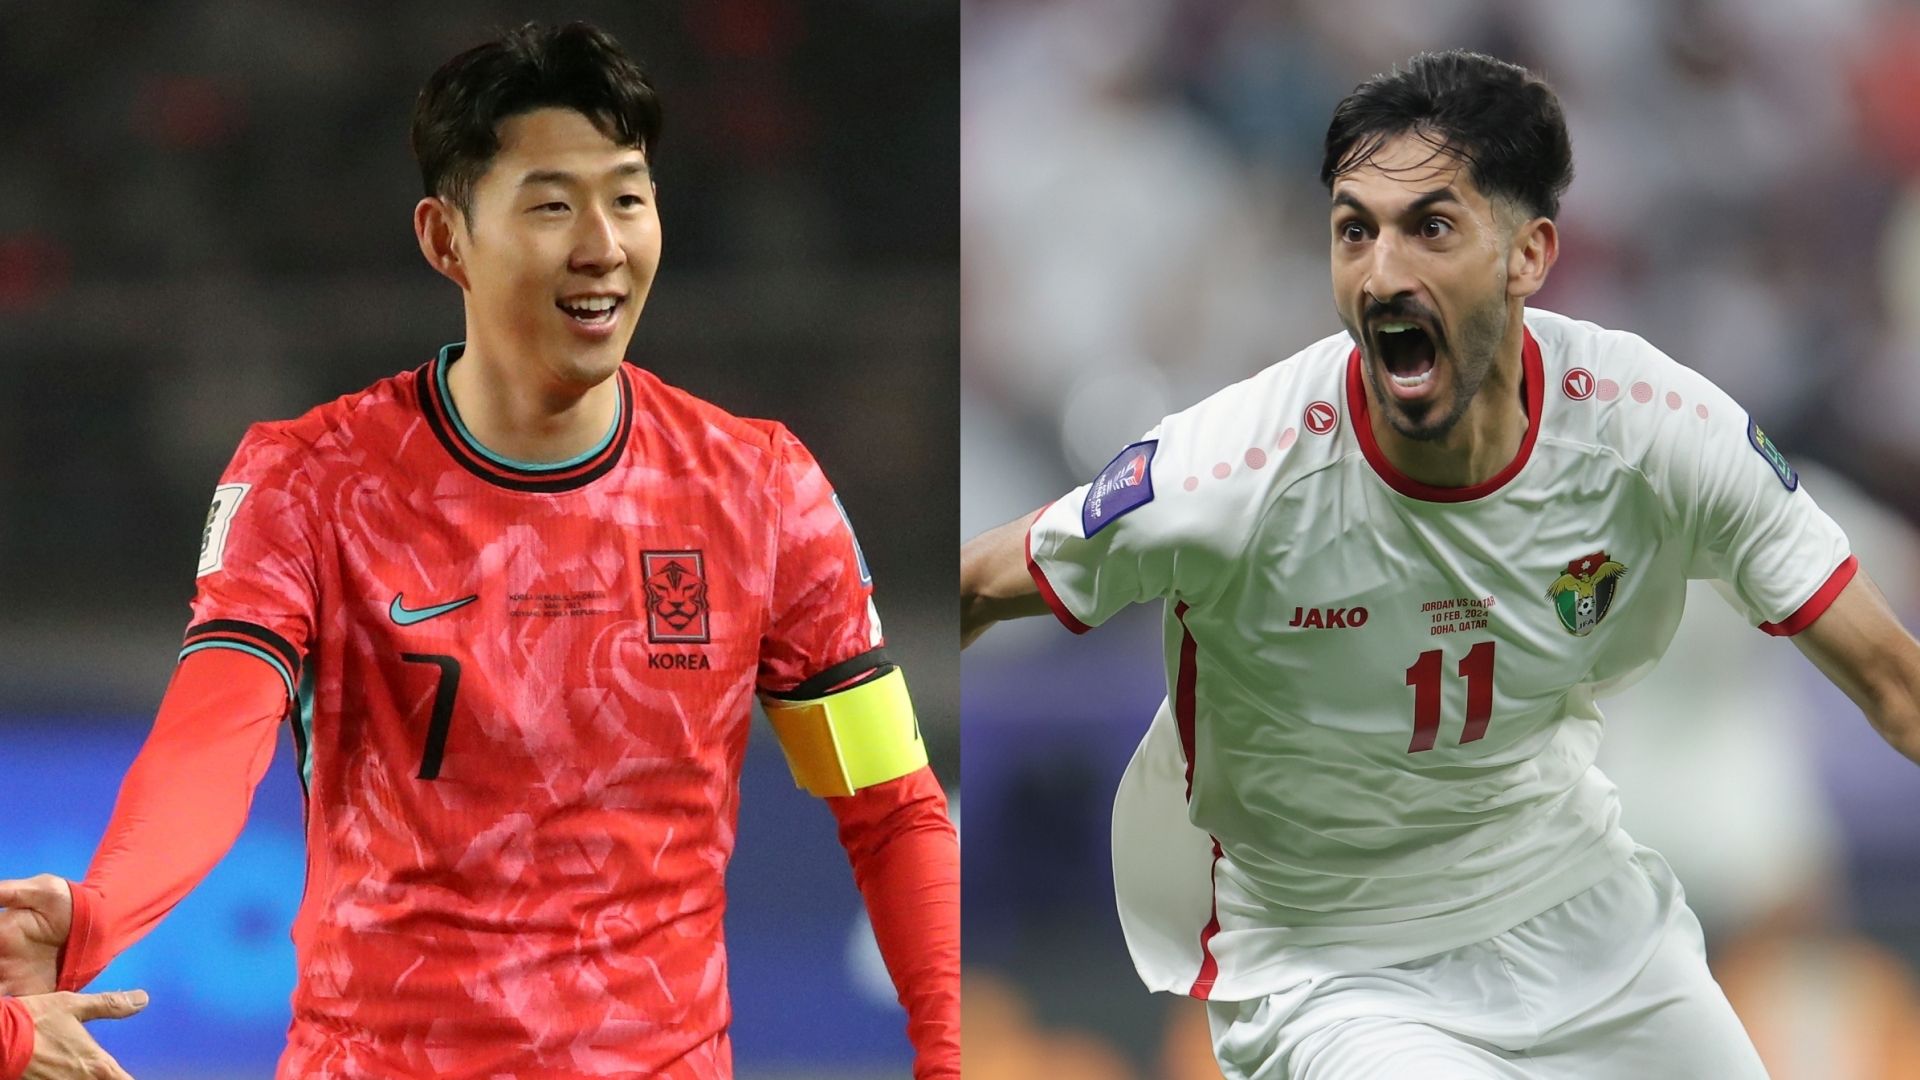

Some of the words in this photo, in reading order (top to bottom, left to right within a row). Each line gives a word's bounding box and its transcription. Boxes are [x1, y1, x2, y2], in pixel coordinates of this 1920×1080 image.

[1421, 599, 1454, 612] JORDAN
[1457, 598, 1468, 607] VS
[1470, 596, 1495, 608] QATAR
[1289, 606, 1368, 629] JAKO
[1432, 614, 1441, 623] 10
[1444, 611, 1462, 621] FEB.
[1459, 619, 1487, 631] QATAR
[648, 653, 710, 670] KOREA
[1406, 640, 1495, 754] 11
[400, 652, 462, 780] 7
